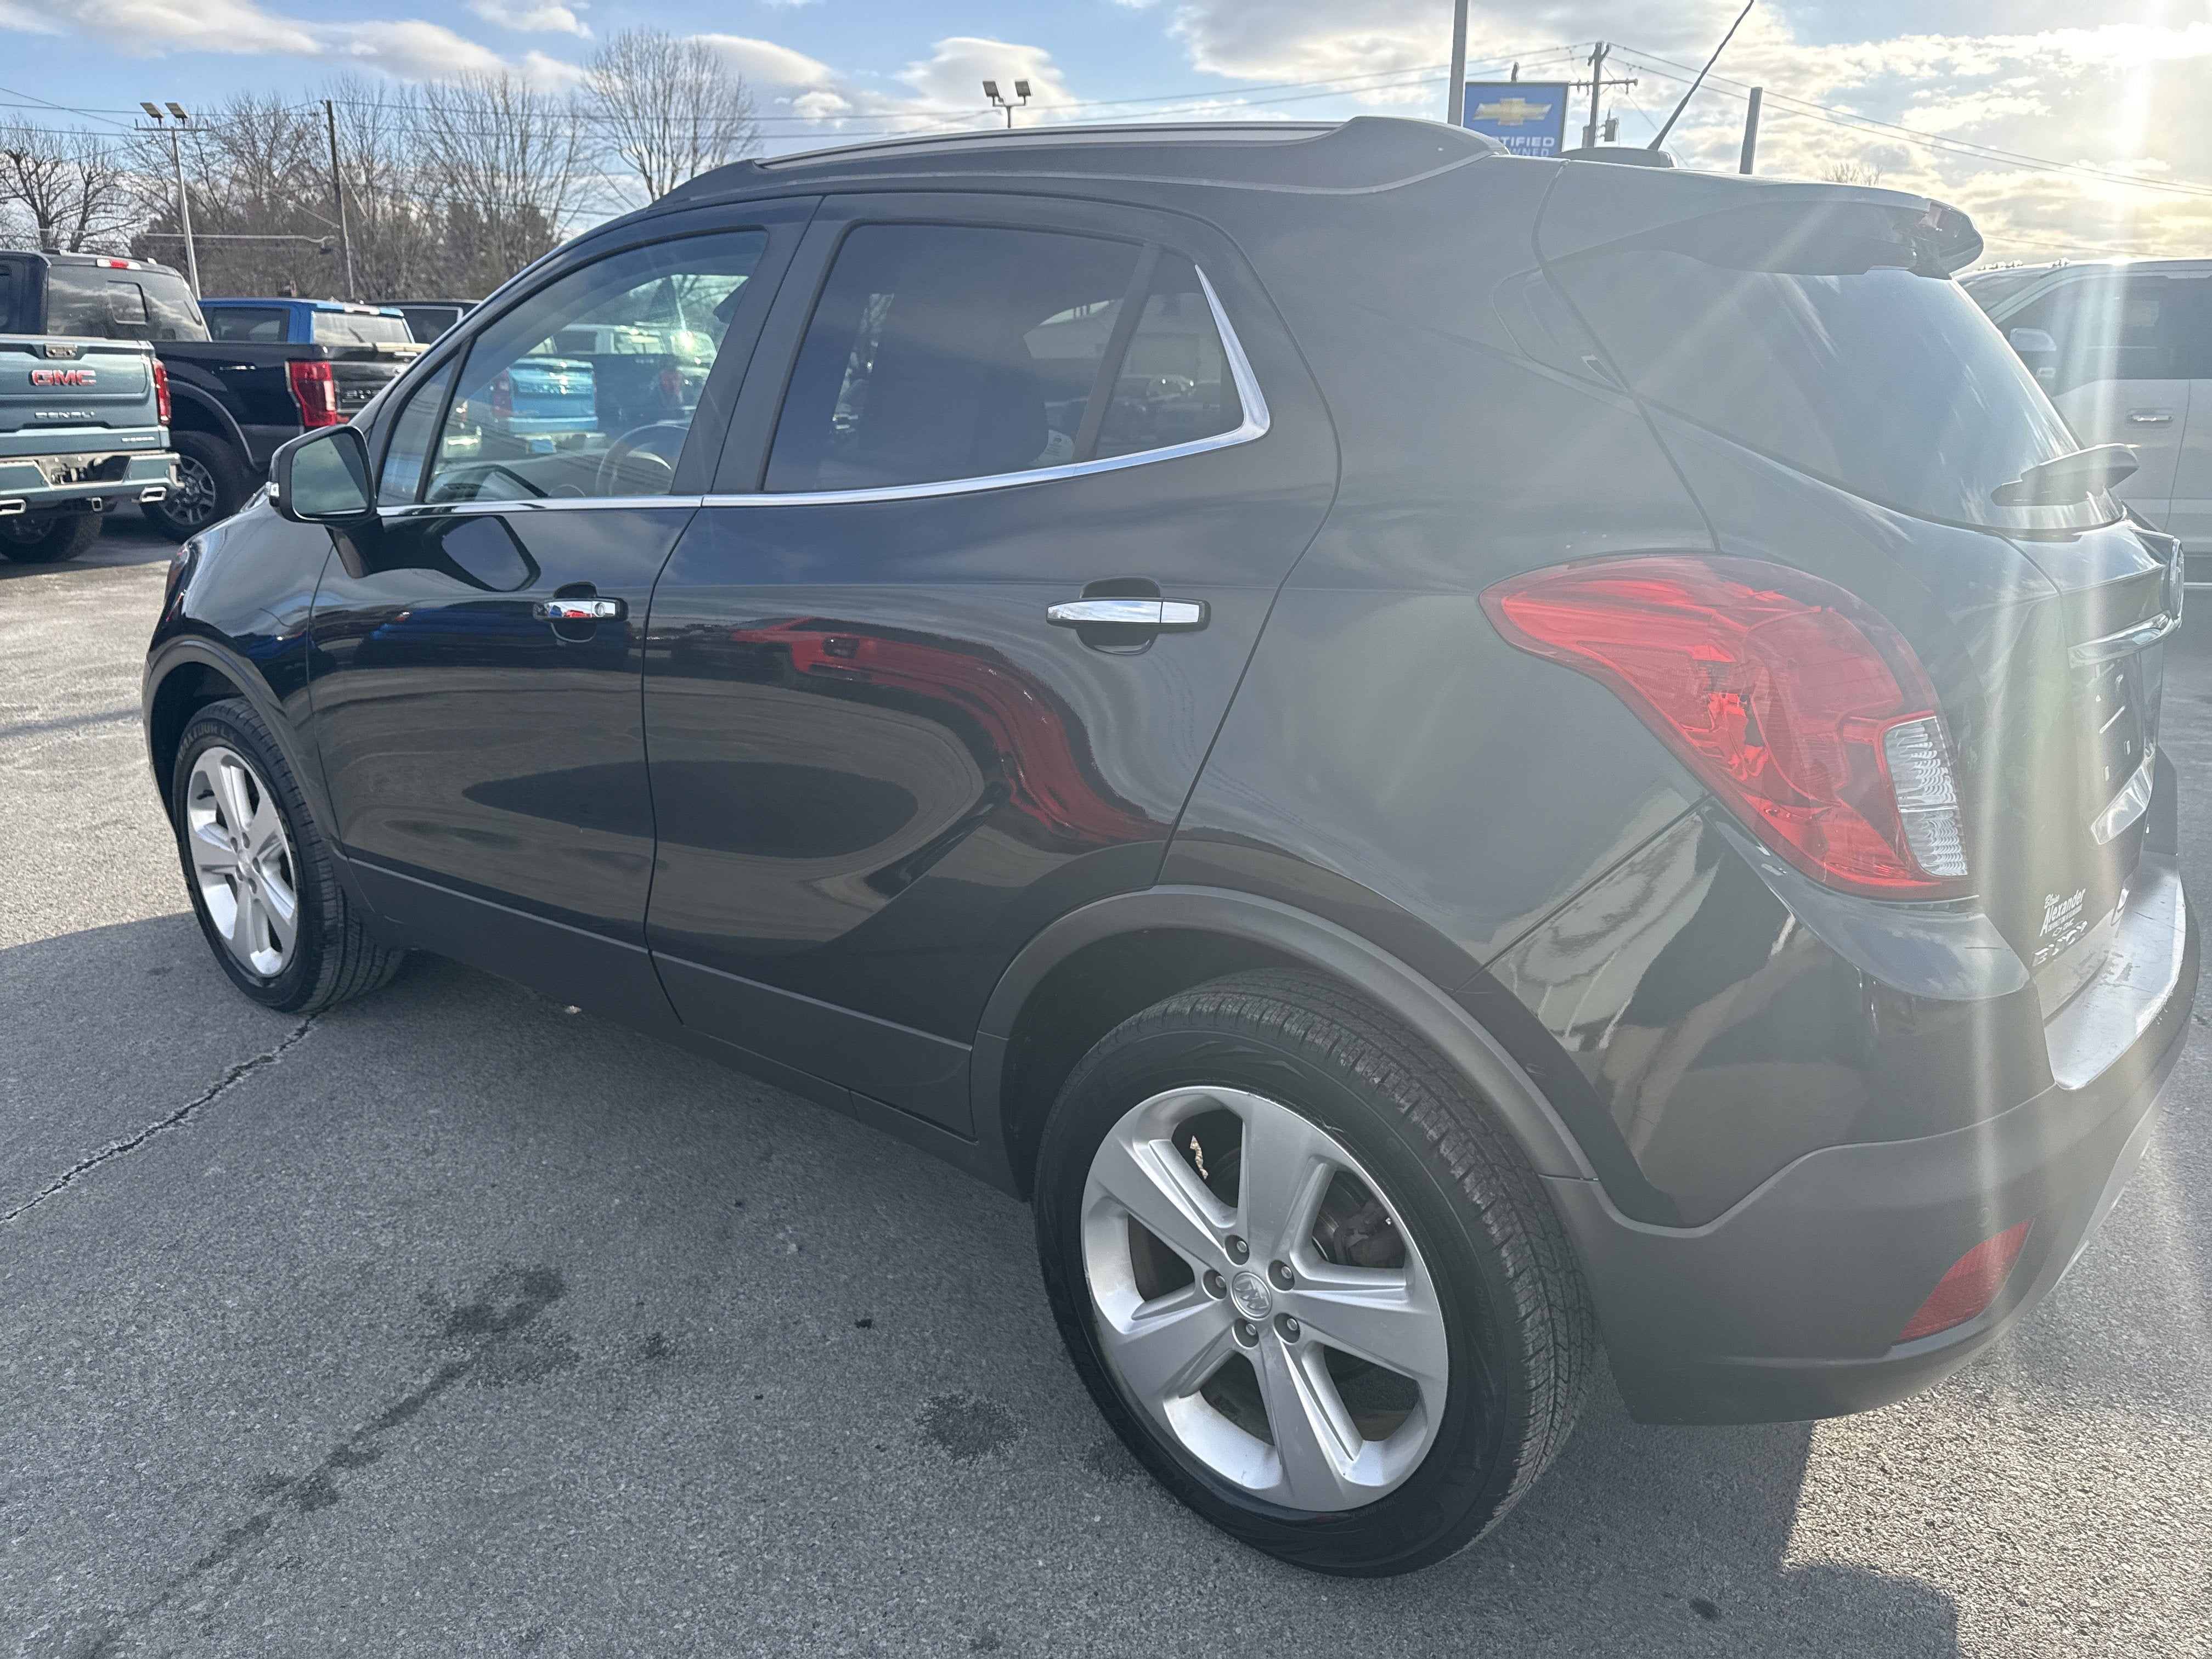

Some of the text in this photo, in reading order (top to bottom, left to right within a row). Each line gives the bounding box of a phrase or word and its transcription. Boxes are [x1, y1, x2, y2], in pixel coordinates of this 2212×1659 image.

[1510, 148, 1549, 156] WNED
[32, 369, 97, 386] GMC
[2039, 888, 2086, 936] Alexander
